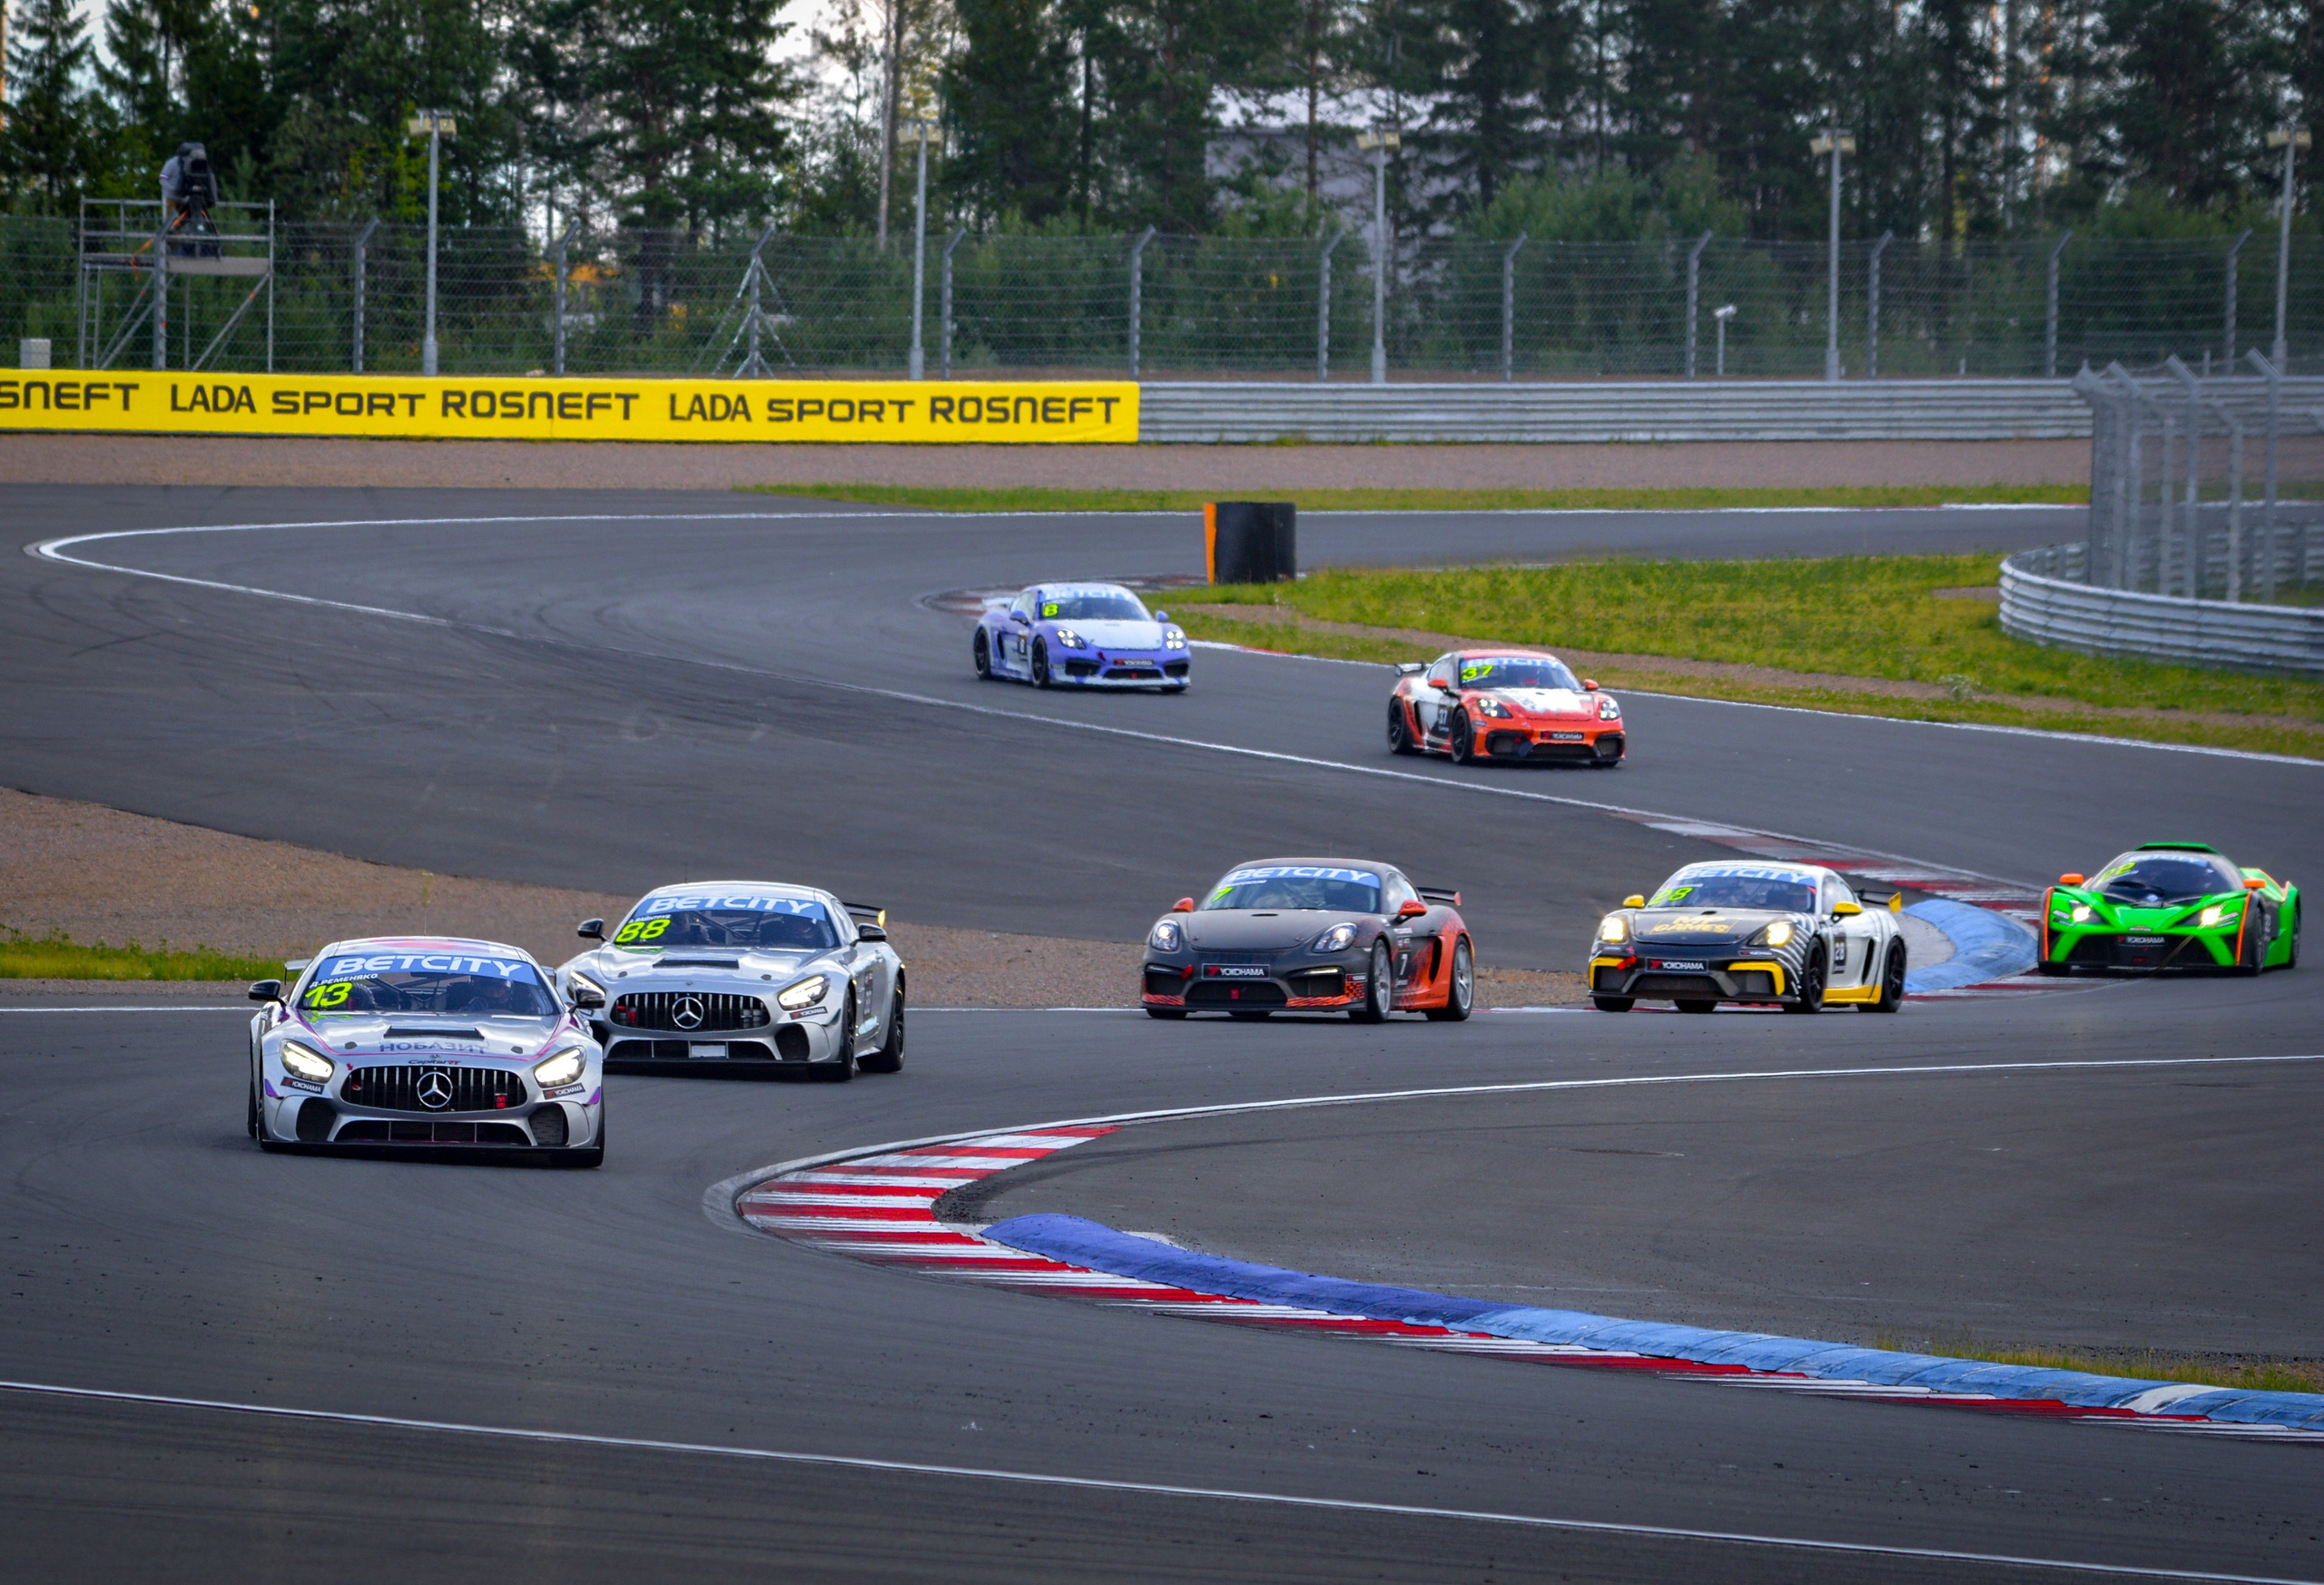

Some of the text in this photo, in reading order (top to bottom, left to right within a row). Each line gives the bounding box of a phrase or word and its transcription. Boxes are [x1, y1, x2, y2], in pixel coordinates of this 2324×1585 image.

[171, 383, 257, 414] LADA
[271, 390, 426, 418] SPORT
[441, 389, 640, 420] ROSNEFT
[669, 393, 753, 422] LADA
[766, 399, 915, 424] SPORT
[929, 396, 1121, 425] ROSNEFT
[1043, 603, 1059, 616] 8
[1466, 657, 1561, 668] BETCITY
[1462, 665, 1494, 681] 37
[1439, 708, 1449, 725] 37
[1229, 866, 1375, 881] BETCITY
[1677, 868, 1810, 883] BETCITY
[1211, 886, 1234, 904] 7
[1648, 886, 1694, 906] 28
[645, 895, 815, 914] BETCITY
[615, 919, 672, 943] 88
[1654, 923, 1730, 933] GAMES
[2126, 936, 2166, 944] YOKOHAMA
[1835, 942, 1845, 960] 28
[330, 955, 524, 978] BETCITY
[1219, 967, 1265, 976] YOKOHAMA
[1400, 953, 1408, 976] 7
[1662, 961, 1705, 970] YOKOHAMA
[305, 981, 353, 1008] 13
[379, 1040, 488, 1054] НОБАЗИТ
[291, 1080, 322, 1093] YOKOHAMA
[554, 1085, 584, 1097] YOKOHAMA
